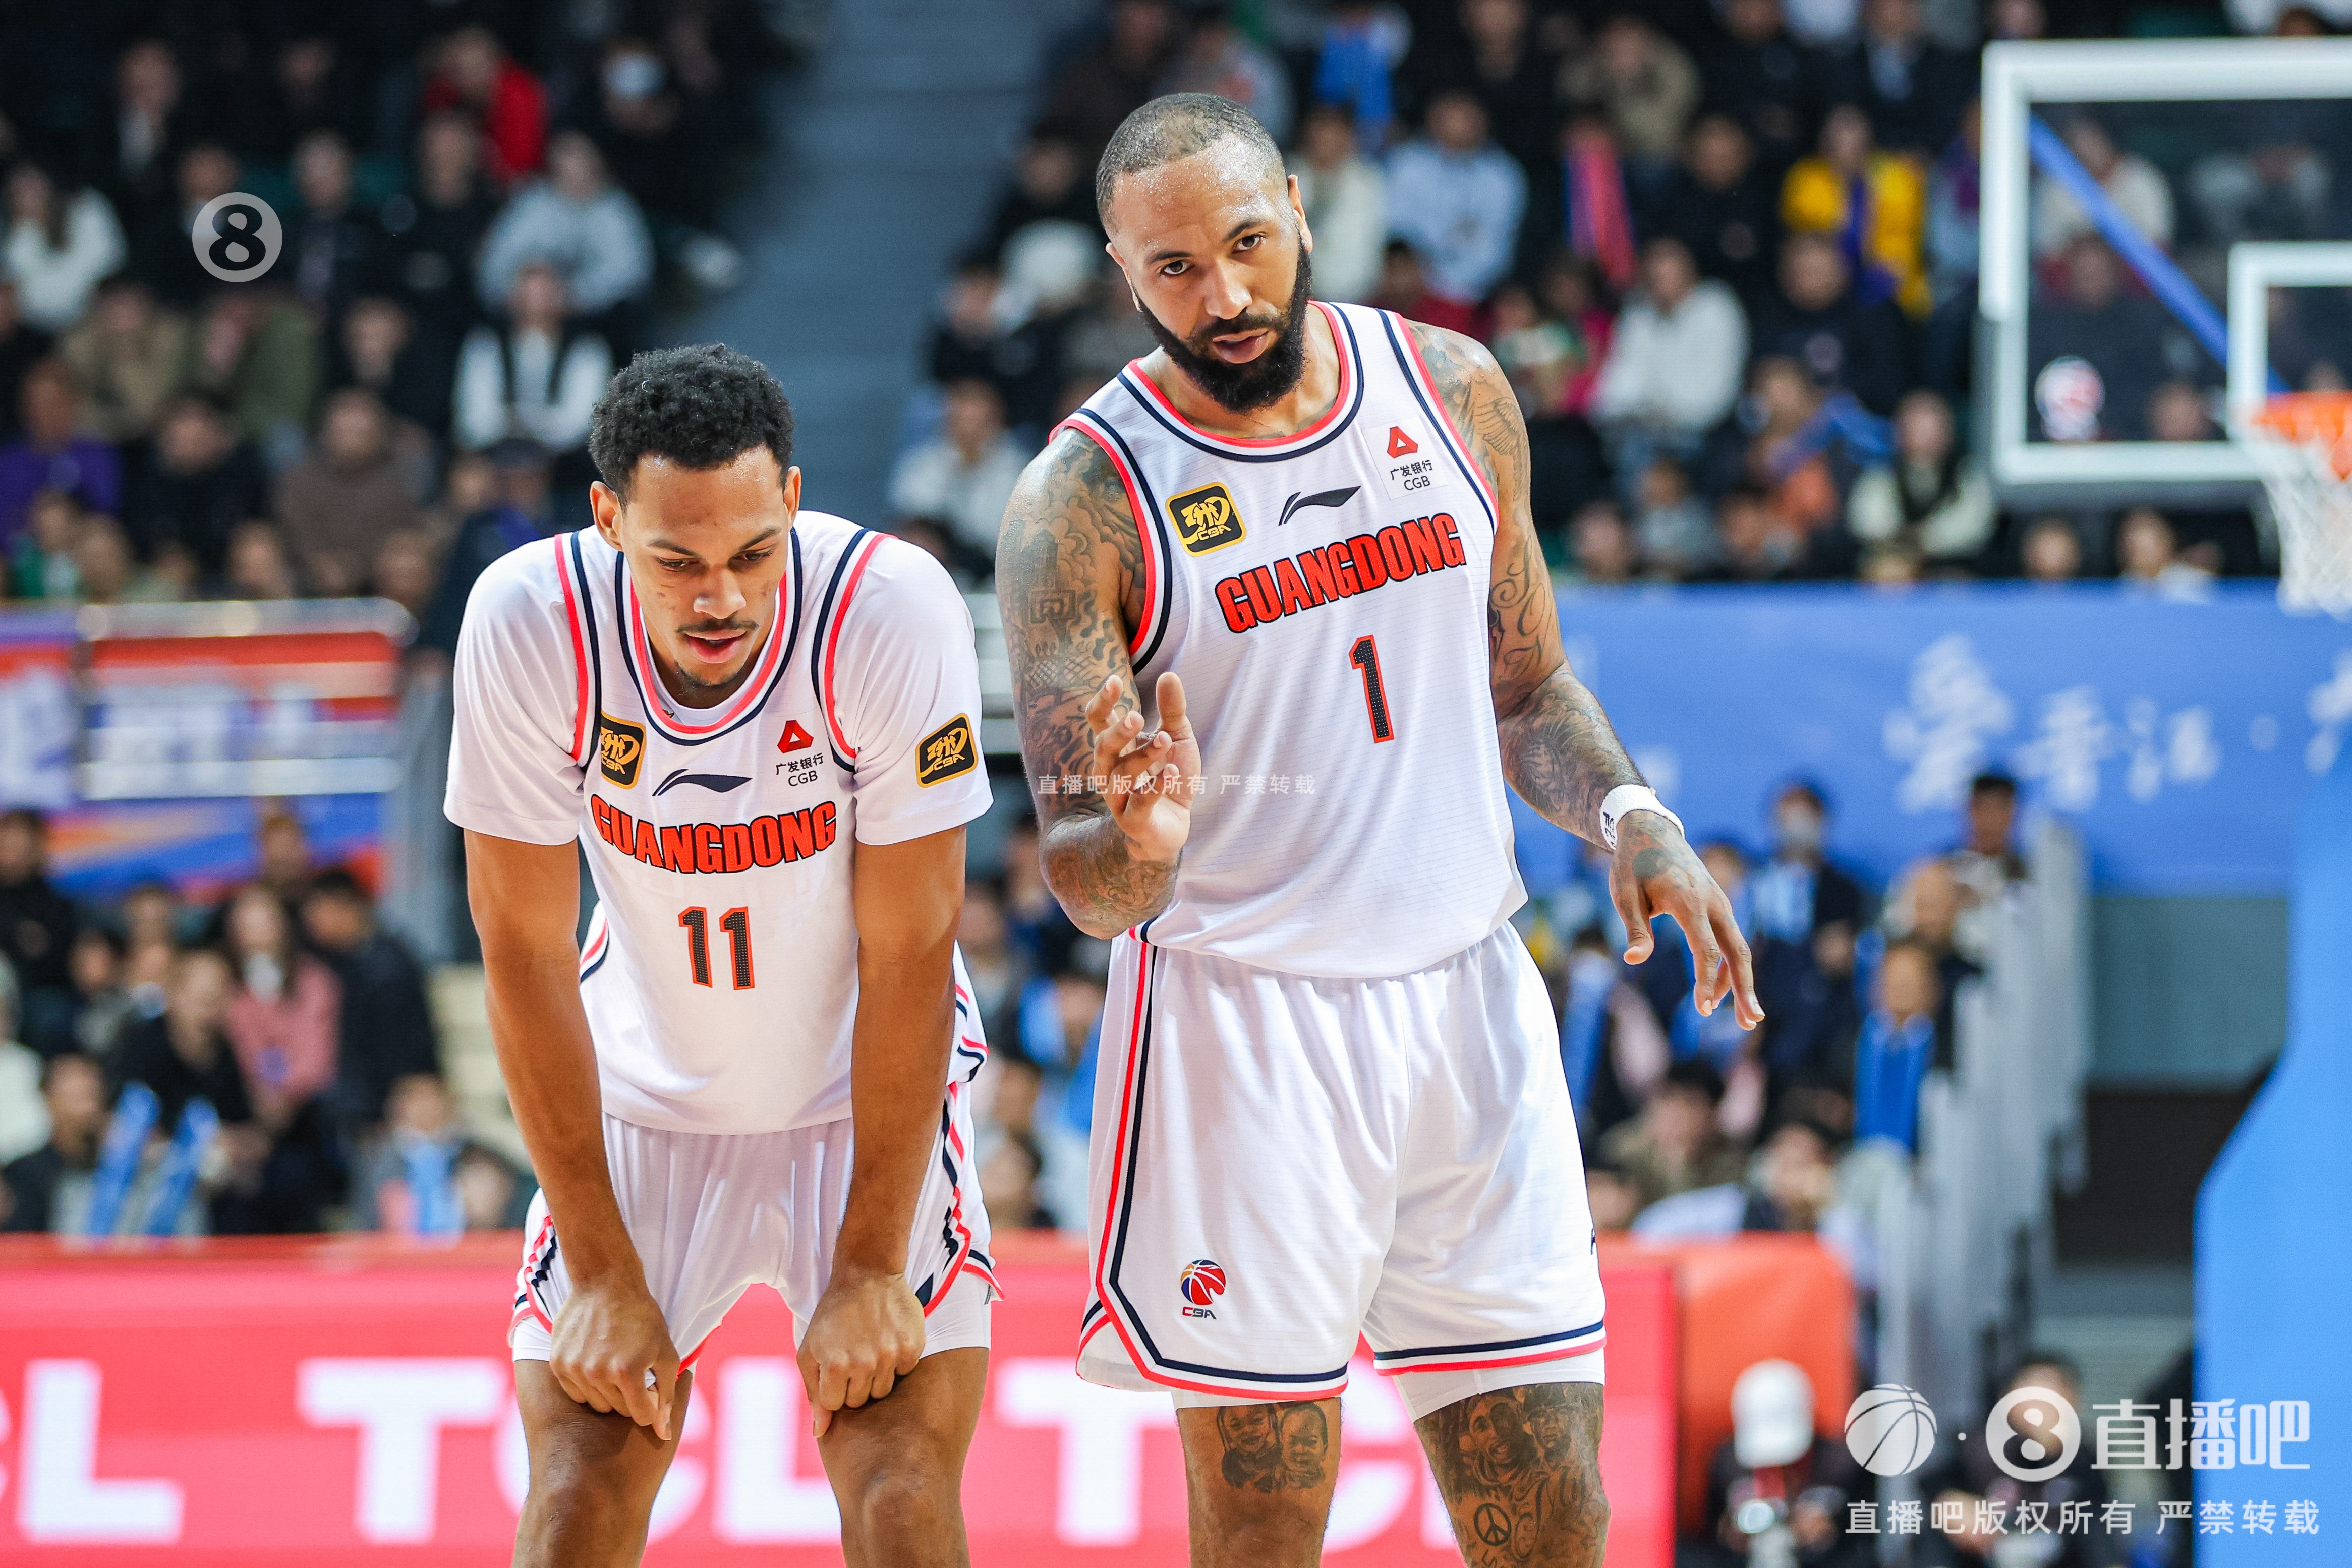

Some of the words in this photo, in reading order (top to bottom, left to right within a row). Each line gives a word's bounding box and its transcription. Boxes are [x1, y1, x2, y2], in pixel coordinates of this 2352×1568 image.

[1390, 459, 1433, 481] 广发银行
[1404, 475, 1430, 491] CGB
[1197, 524, 1232, 541] CBA
[1215, 513, 1466, 633] GUANGDONG
[1348, 634, 1395, 743] 1
[776, 752, 823, 775] 广发银行
[934, 754, 965, 771] CBA
[788, 770, 818, 786] CGB
[590, 794, 837, 874] GUANGDONG
[678, 906, 756, 990] 11
[1182, 1306, 1217, 1320] CBA
